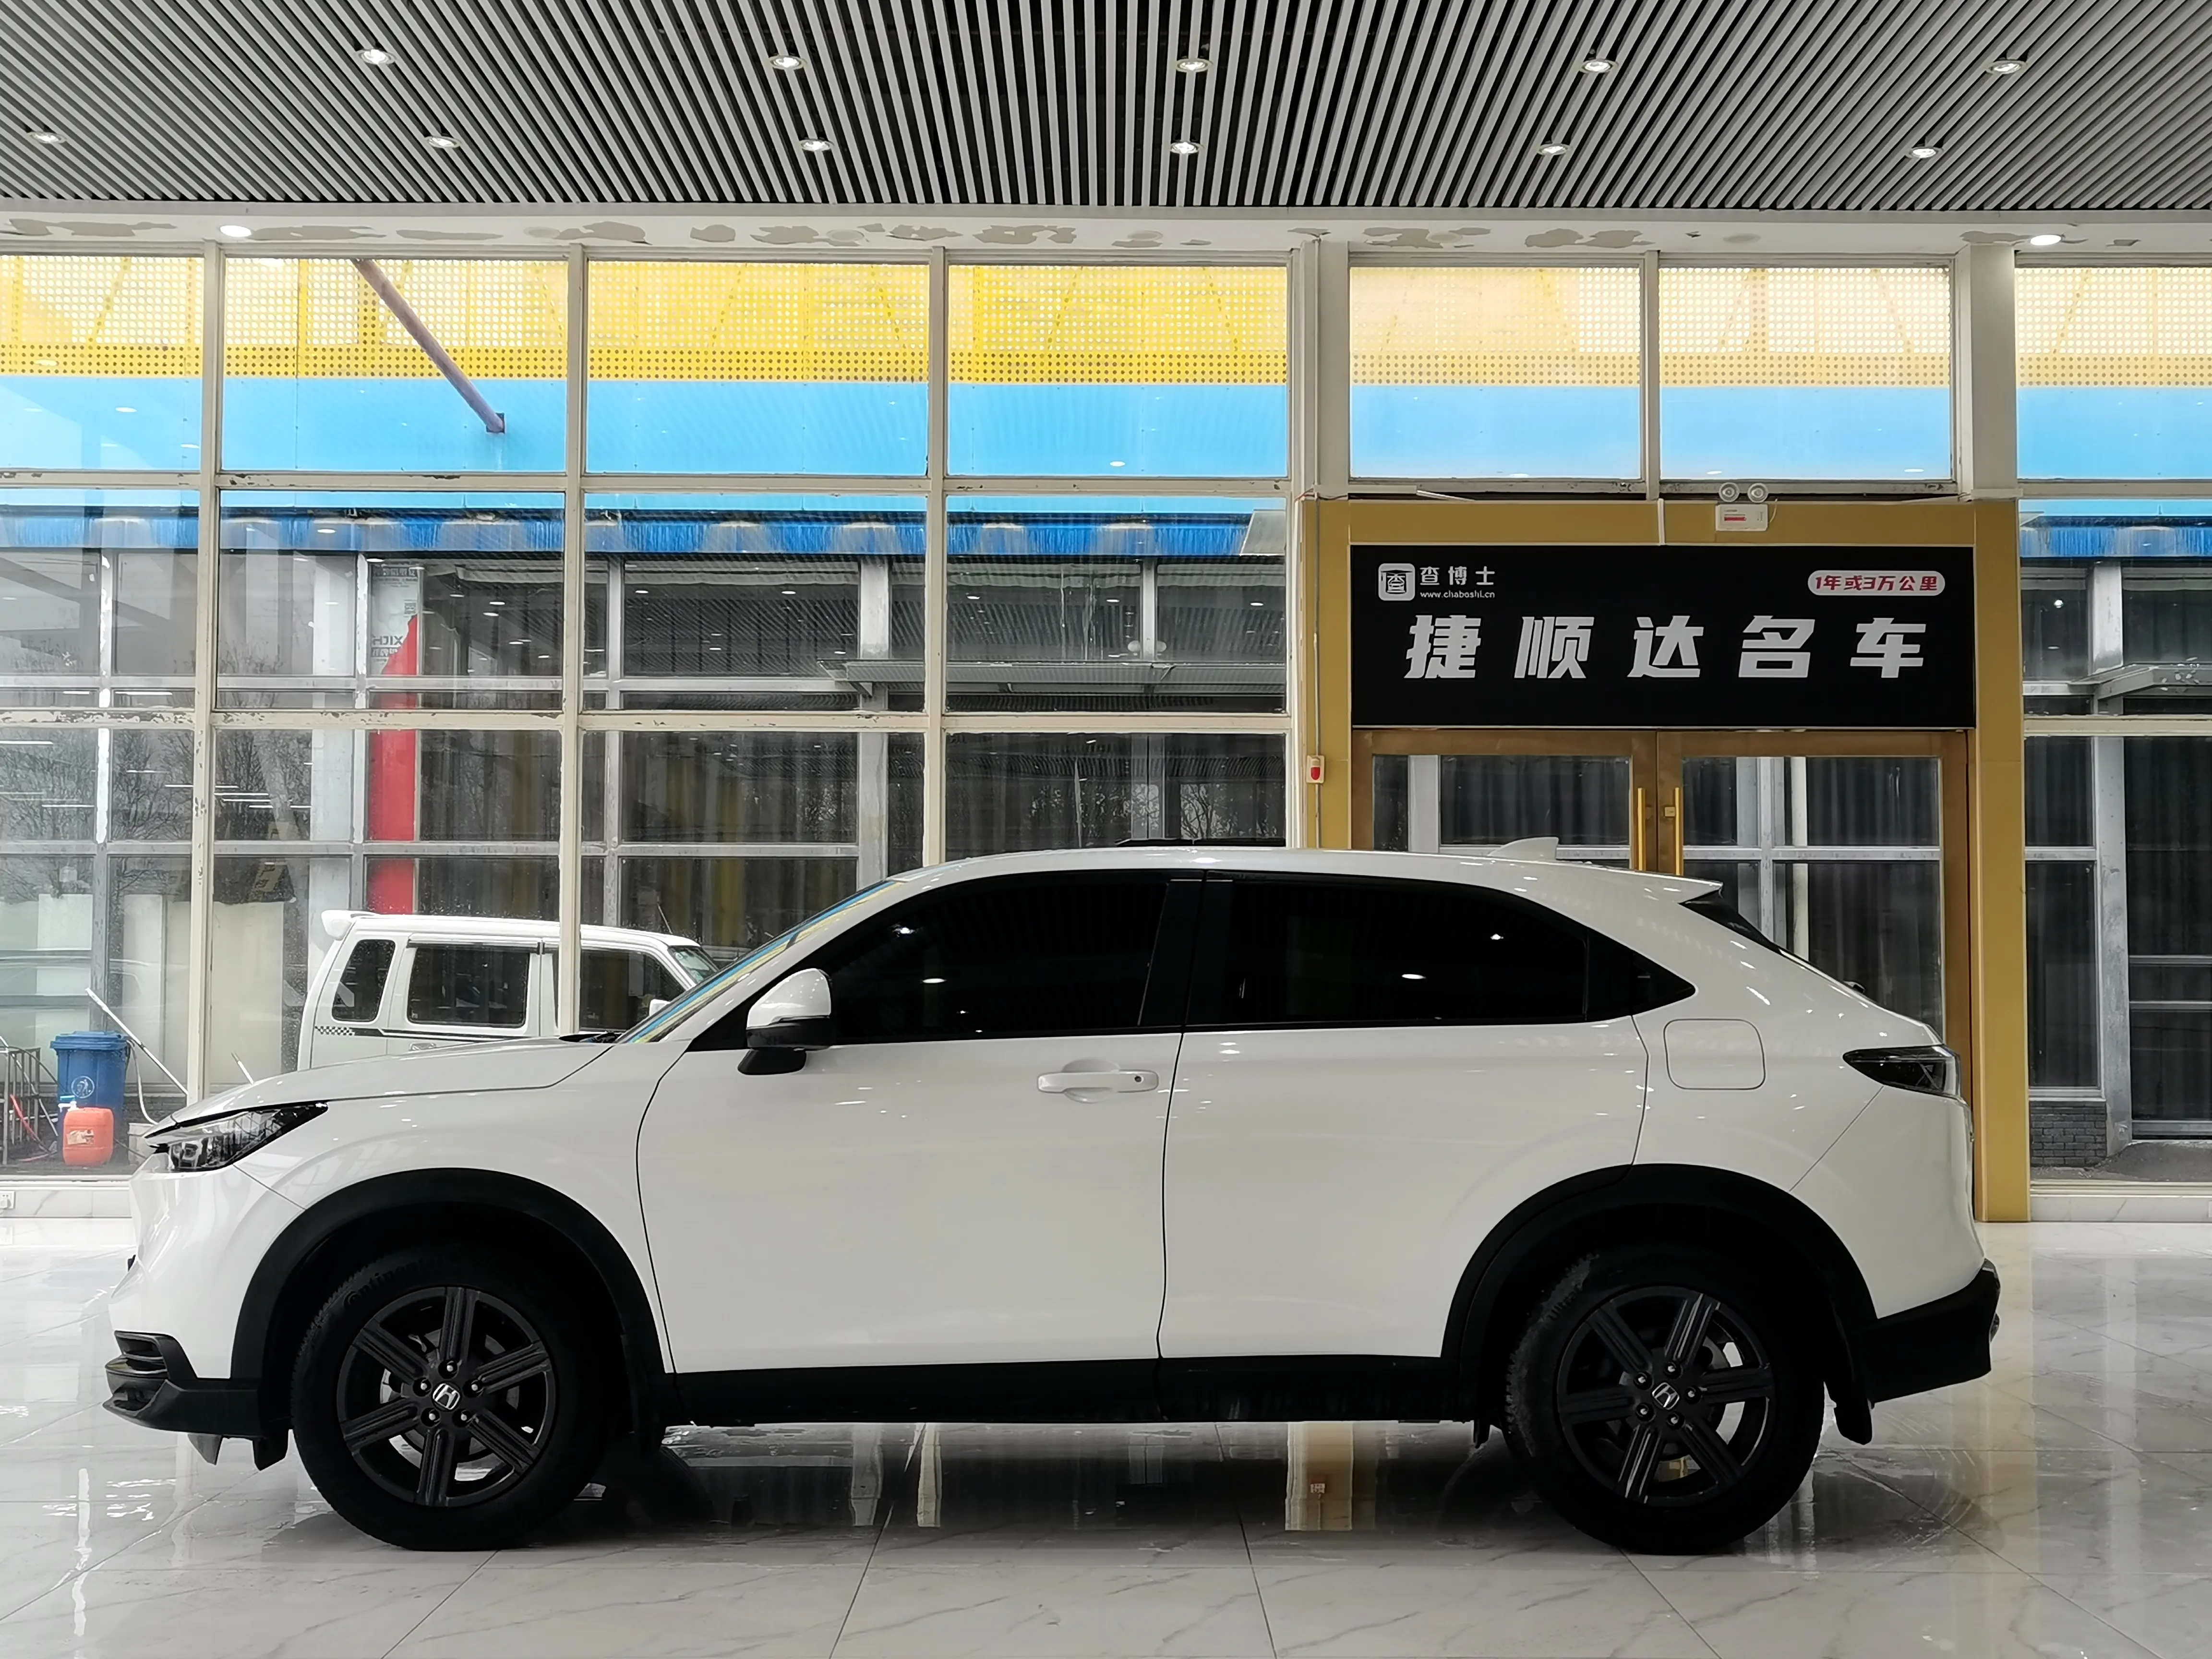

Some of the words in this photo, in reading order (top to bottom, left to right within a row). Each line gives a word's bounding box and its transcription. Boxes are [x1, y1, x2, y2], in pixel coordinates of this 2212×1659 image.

[1420, 566, 1495, 585] 查博士
[1815, 575, 1937, 591] 1年或3万公里
[1404, 615, 1926, 678] 捷顺达名车
